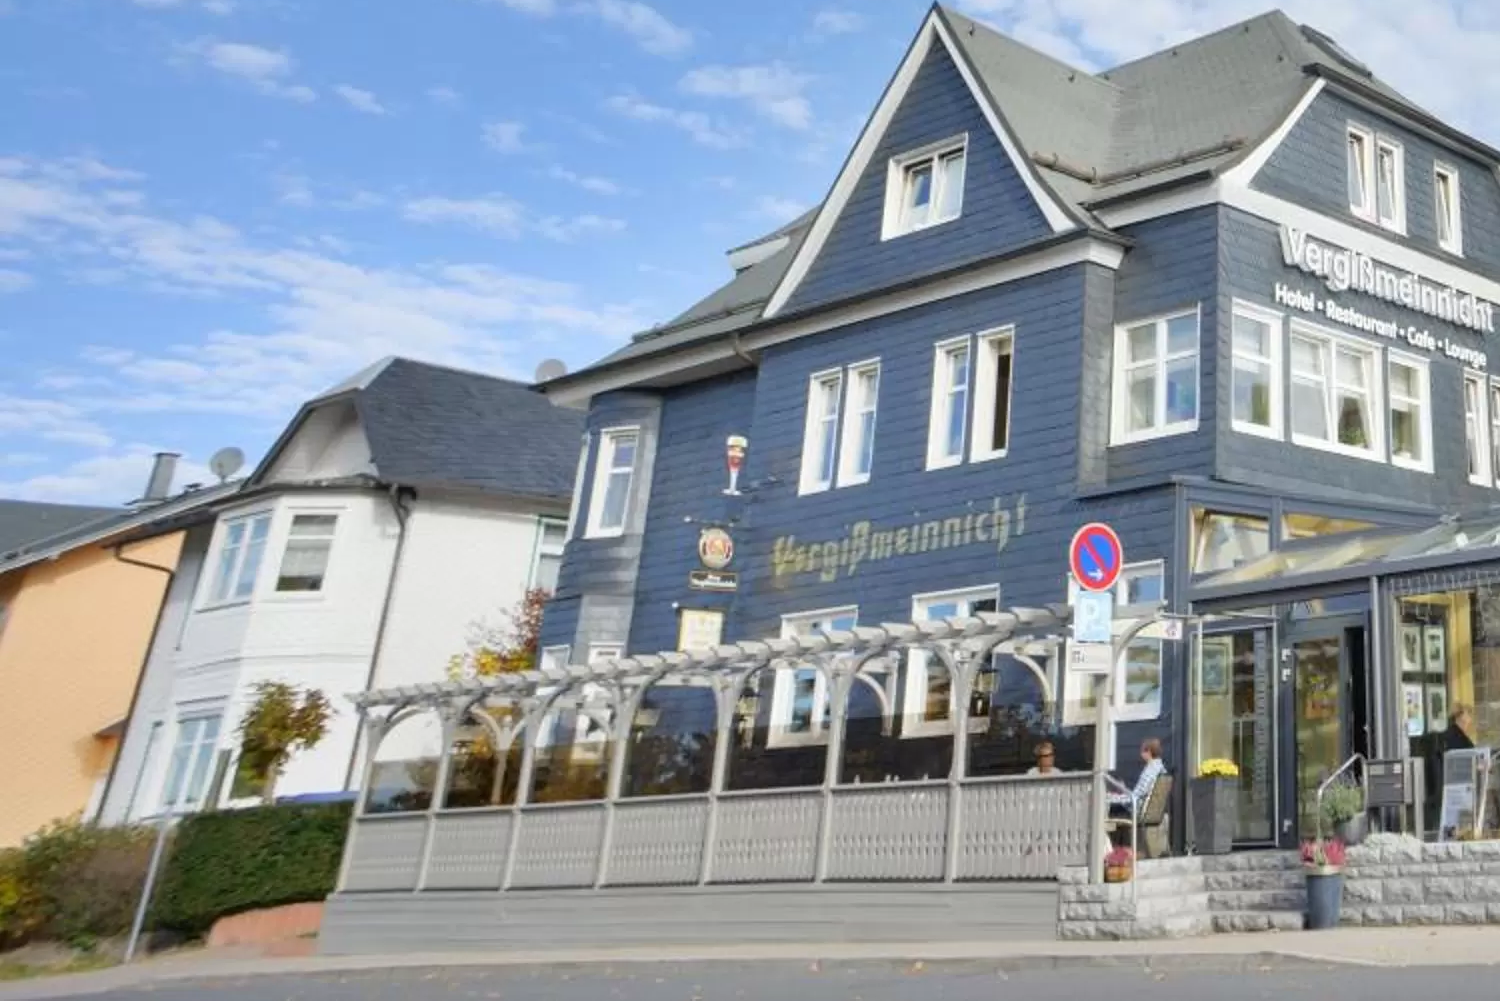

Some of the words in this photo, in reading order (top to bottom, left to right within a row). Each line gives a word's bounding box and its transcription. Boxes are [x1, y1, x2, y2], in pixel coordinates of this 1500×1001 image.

[1275, 282, 1315, 312] Hotel
[1325, 299, 1397, 339] Restaurant
[1445, 337, 1487, 368] Lounge
[1279, 223, 1495, 333] Vergißmeinnicht
